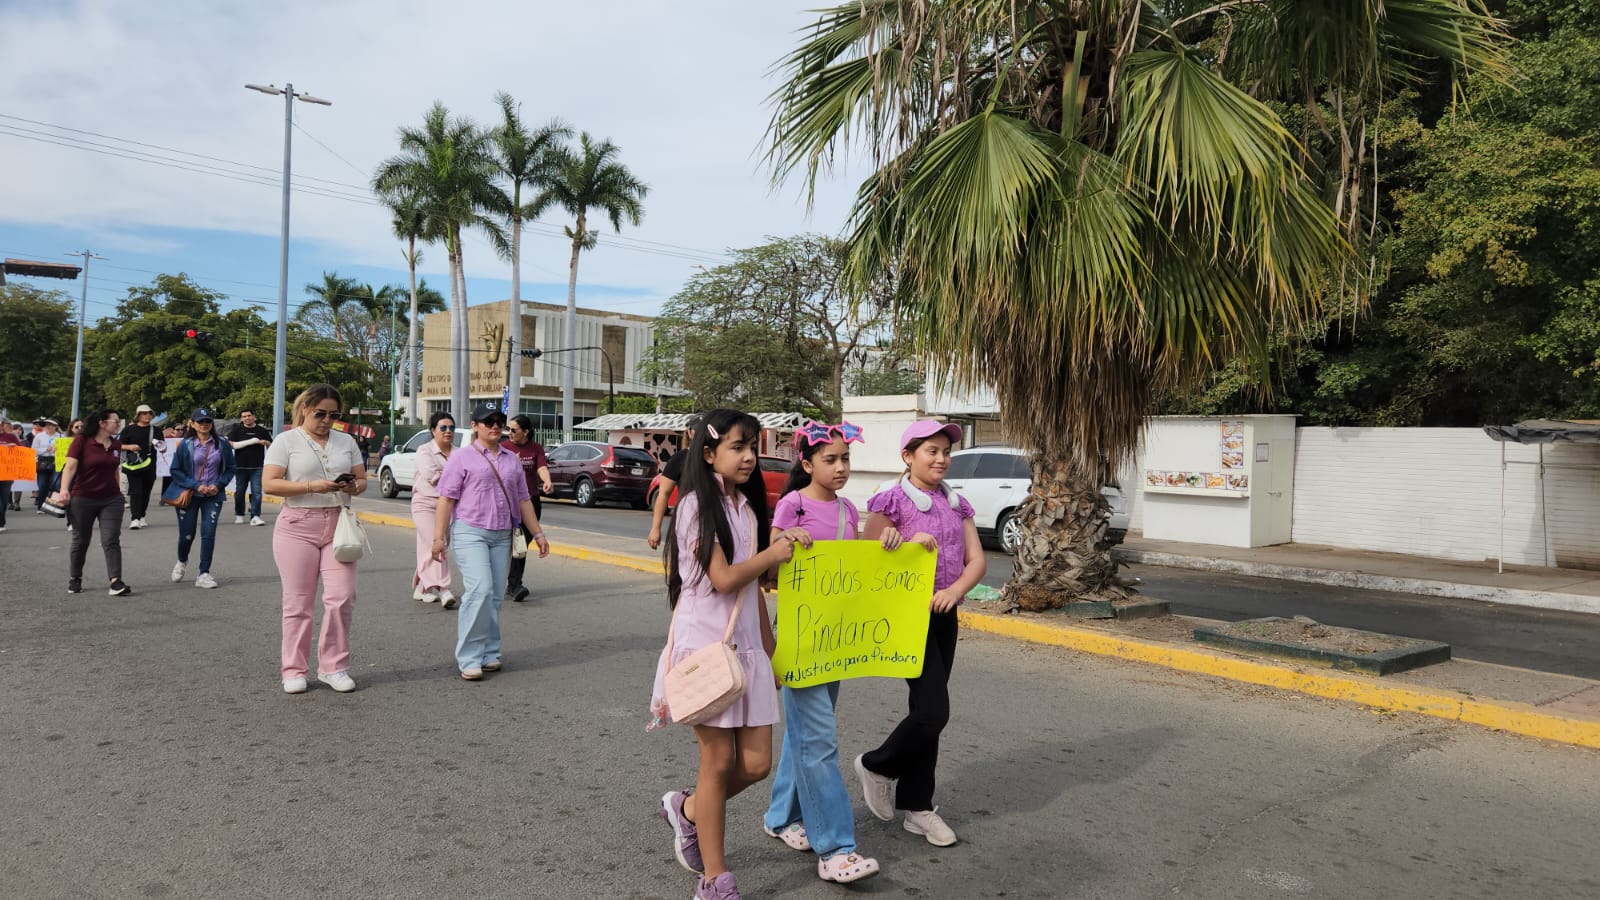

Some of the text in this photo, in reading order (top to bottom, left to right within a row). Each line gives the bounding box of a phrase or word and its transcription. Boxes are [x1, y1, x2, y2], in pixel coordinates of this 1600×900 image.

[427, 374, 447, 383] CENTRO
[483, 370, 503, 380] SOCIAL
[478, 383, 503, 393] FAMILIAR
[785, 553, 926, 596] #Todos somos
[795, 604, 890, 665] Píndaro
